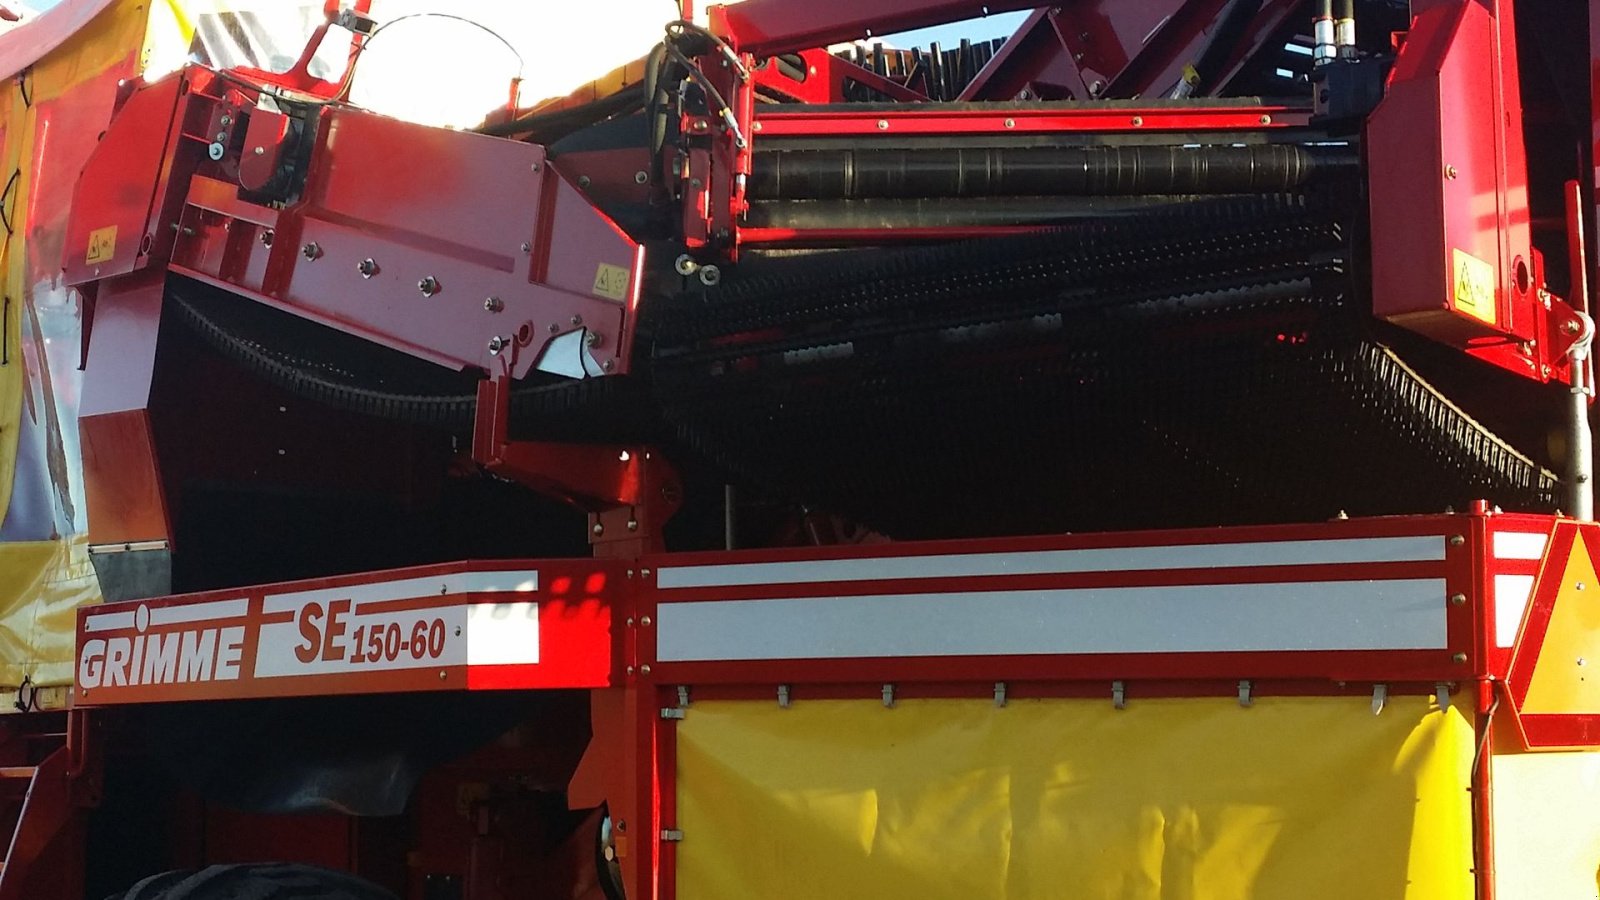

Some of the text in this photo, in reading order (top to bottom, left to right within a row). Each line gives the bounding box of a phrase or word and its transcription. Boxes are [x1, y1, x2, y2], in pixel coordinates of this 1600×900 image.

[79, 604, 245, 689] GRIMME
[294, 599, 446, 664] SE 150-60
